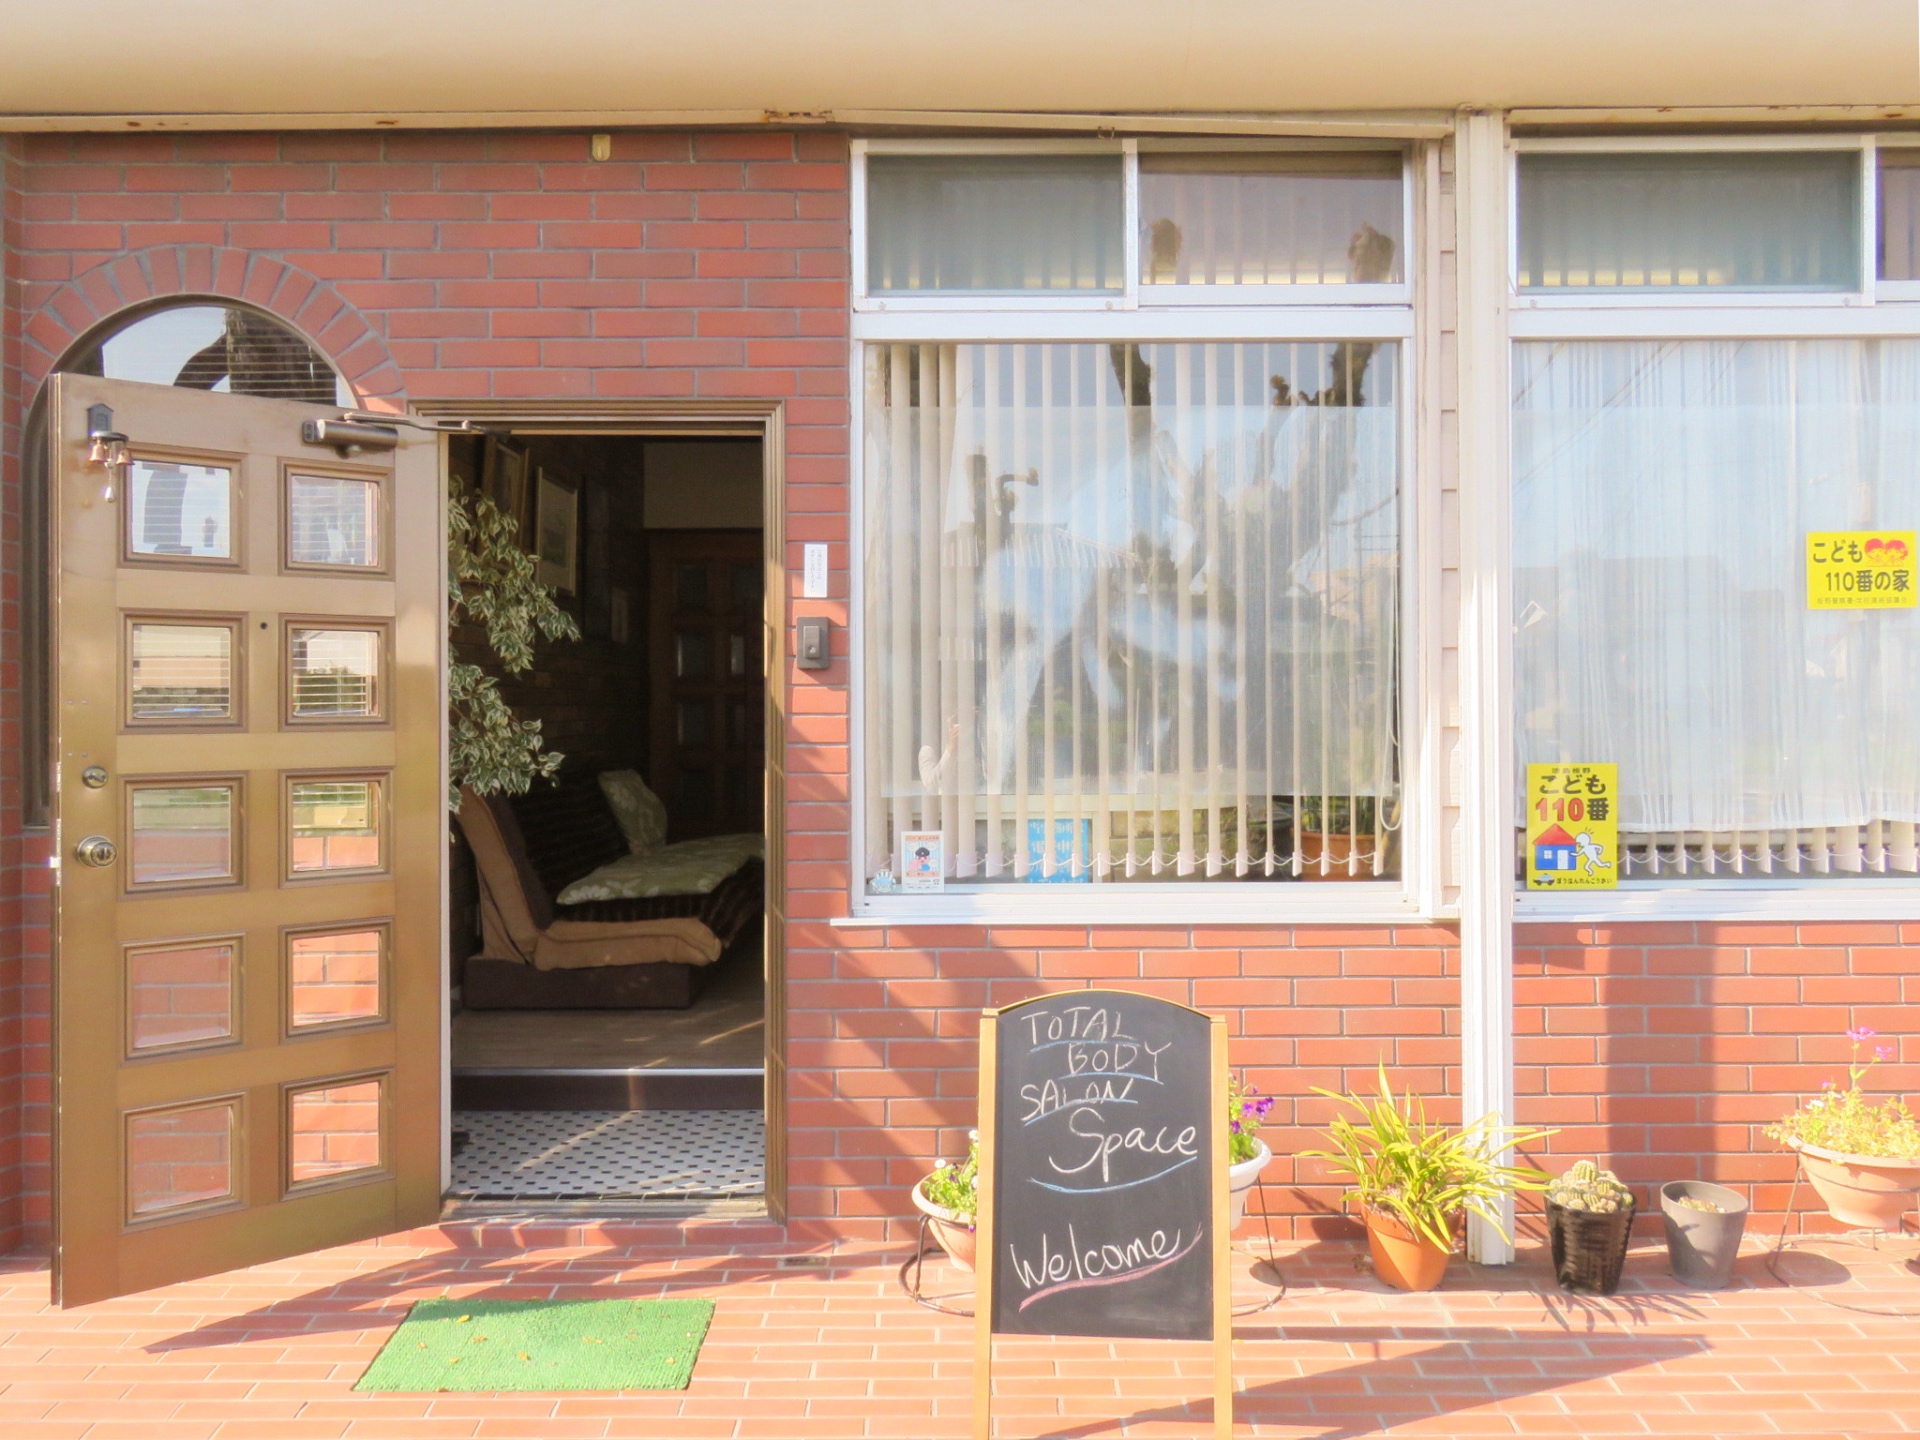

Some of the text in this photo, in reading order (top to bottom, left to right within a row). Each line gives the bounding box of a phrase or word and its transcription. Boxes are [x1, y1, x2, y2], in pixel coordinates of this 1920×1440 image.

[1813, 539, 1863, 563] こども
[1825, 569, 1910, 592] 110番の家
[1539, 774, 1606, 794] こども
[1535, 797, 1609, 822] 110番
[1020, 1006, 1136, 1045] TOTAL
[1068, 1041, 1172, 1081] BODY
[1020, 1078, 1134, 1121] SALON
[1048, 1107, 1198, 1182] Space
[1010, 1223, 1181, 1289] Welcome
